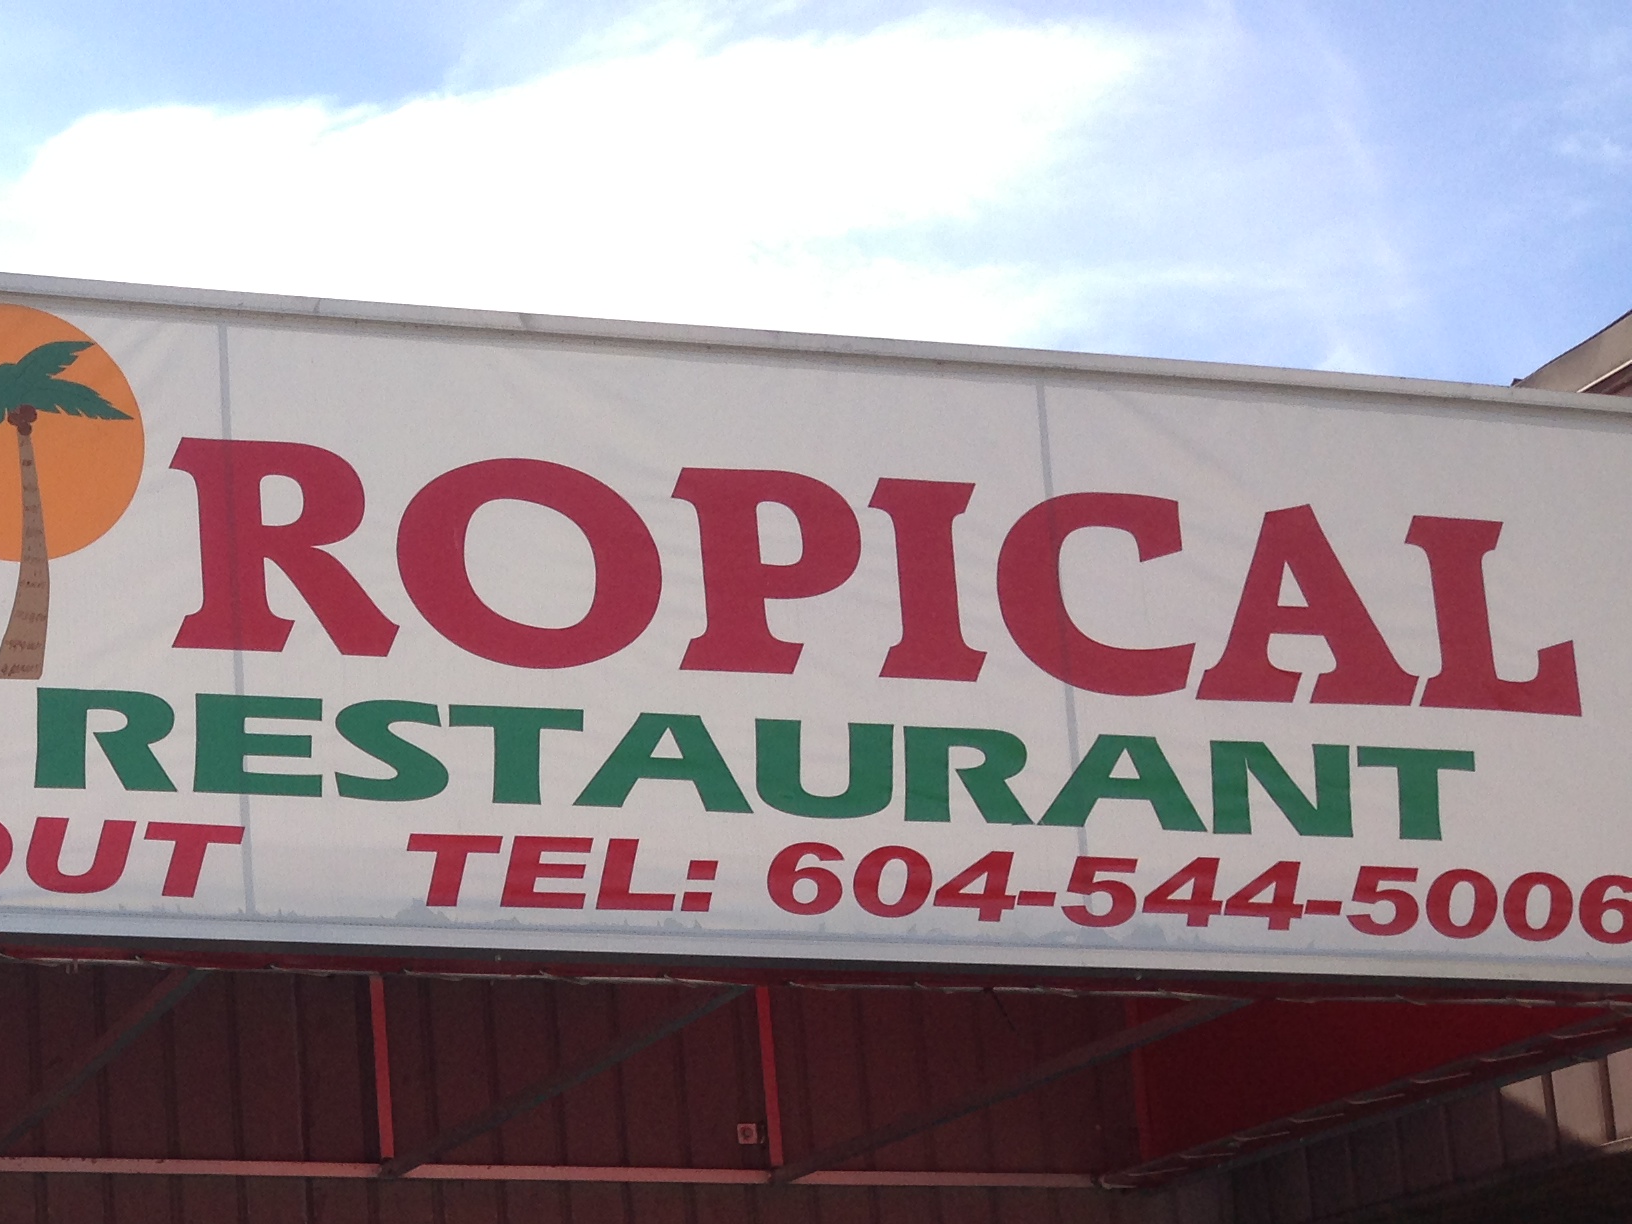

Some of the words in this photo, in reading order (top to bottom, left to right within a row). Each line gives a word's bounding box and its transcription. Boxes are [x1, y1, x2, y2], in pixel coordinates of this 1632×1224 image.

[34, 685, 1476, 843] RESTAURANT
[406, 832, 718, 913] TEL:
[768, 841, 1632, 945] 604-544-5006
